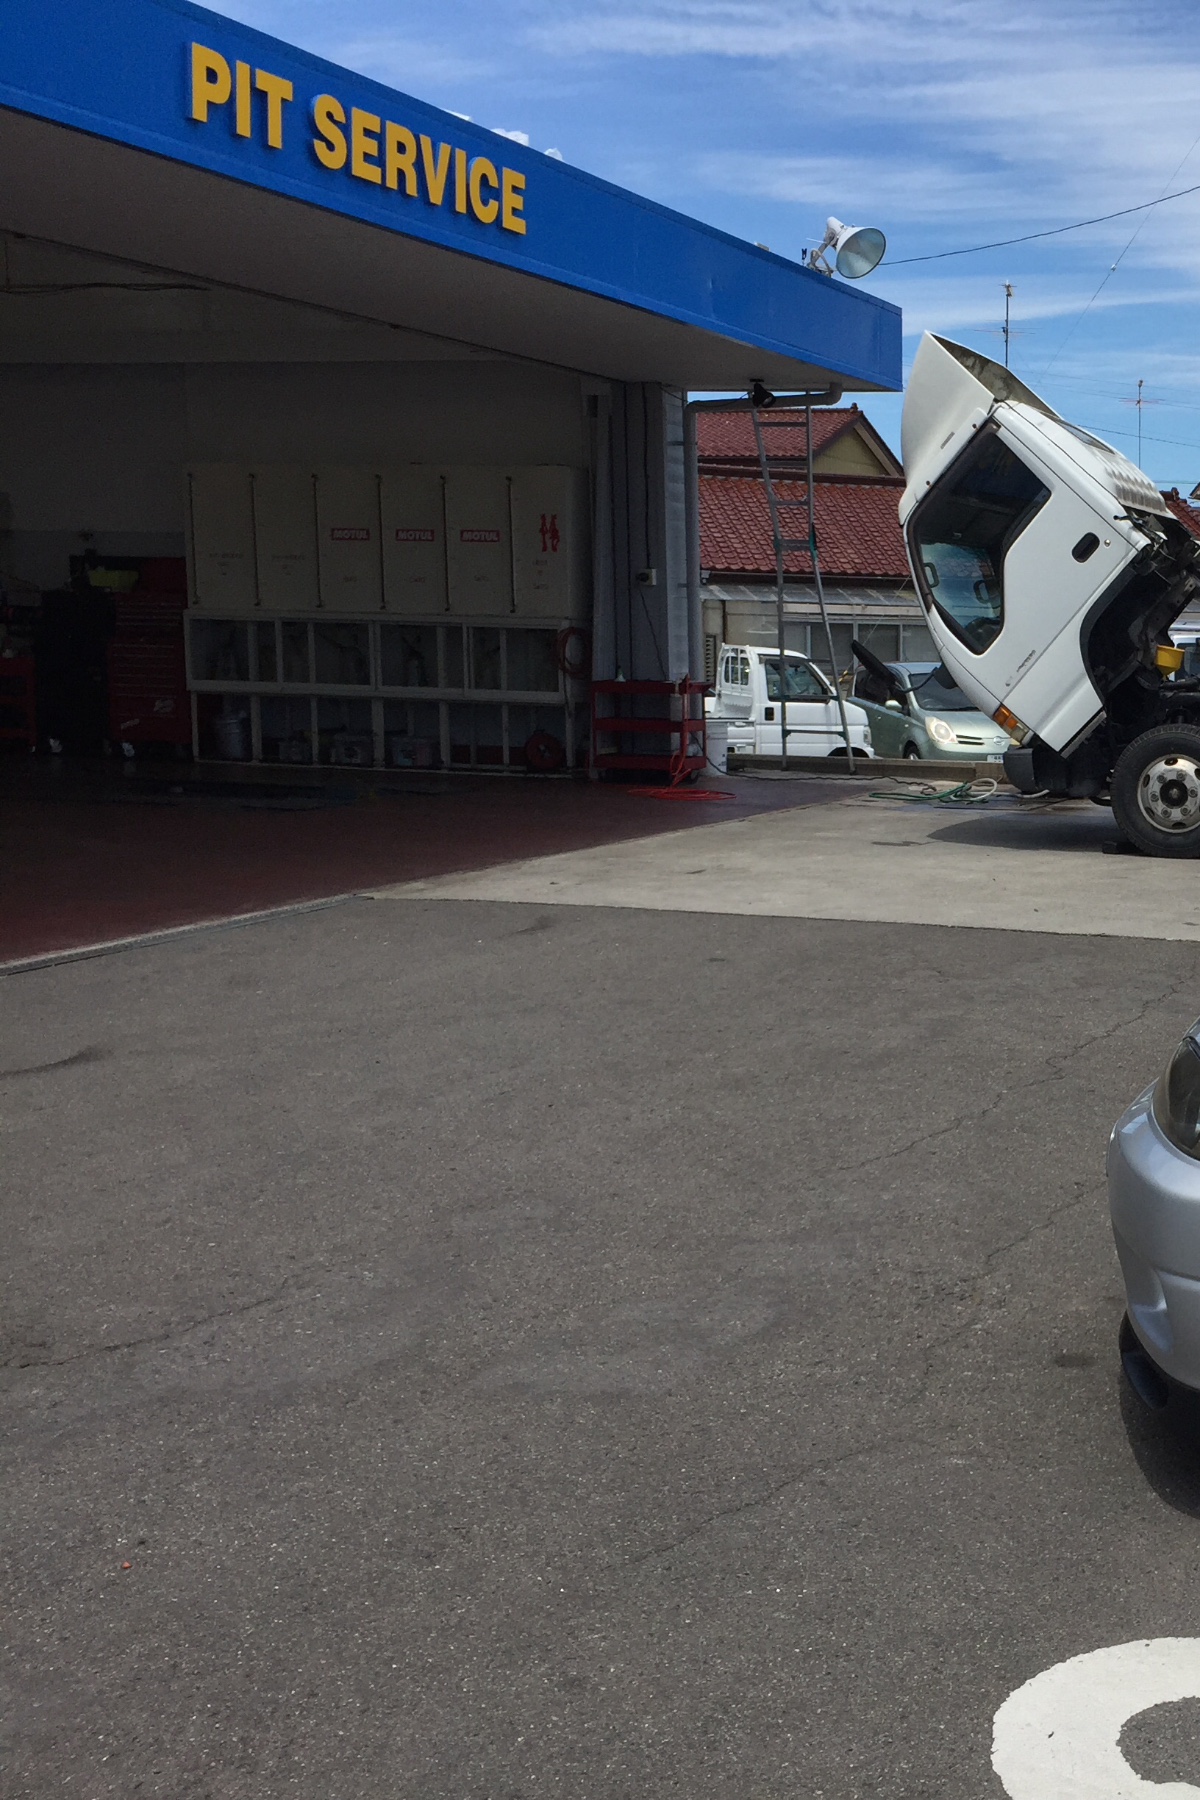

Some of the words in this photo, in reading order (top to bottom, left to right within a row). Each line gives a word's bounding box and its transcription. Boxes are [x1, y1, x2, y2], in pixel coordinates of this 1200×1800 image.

[190, 42, 293, 149] PIT
[312, 93, 526, 235] SERVICE
[333, 529, 369, 540] MOTUL
[396, 530, 433, 540] MOTUL
[462, 531, 499, 541] MOTUL
